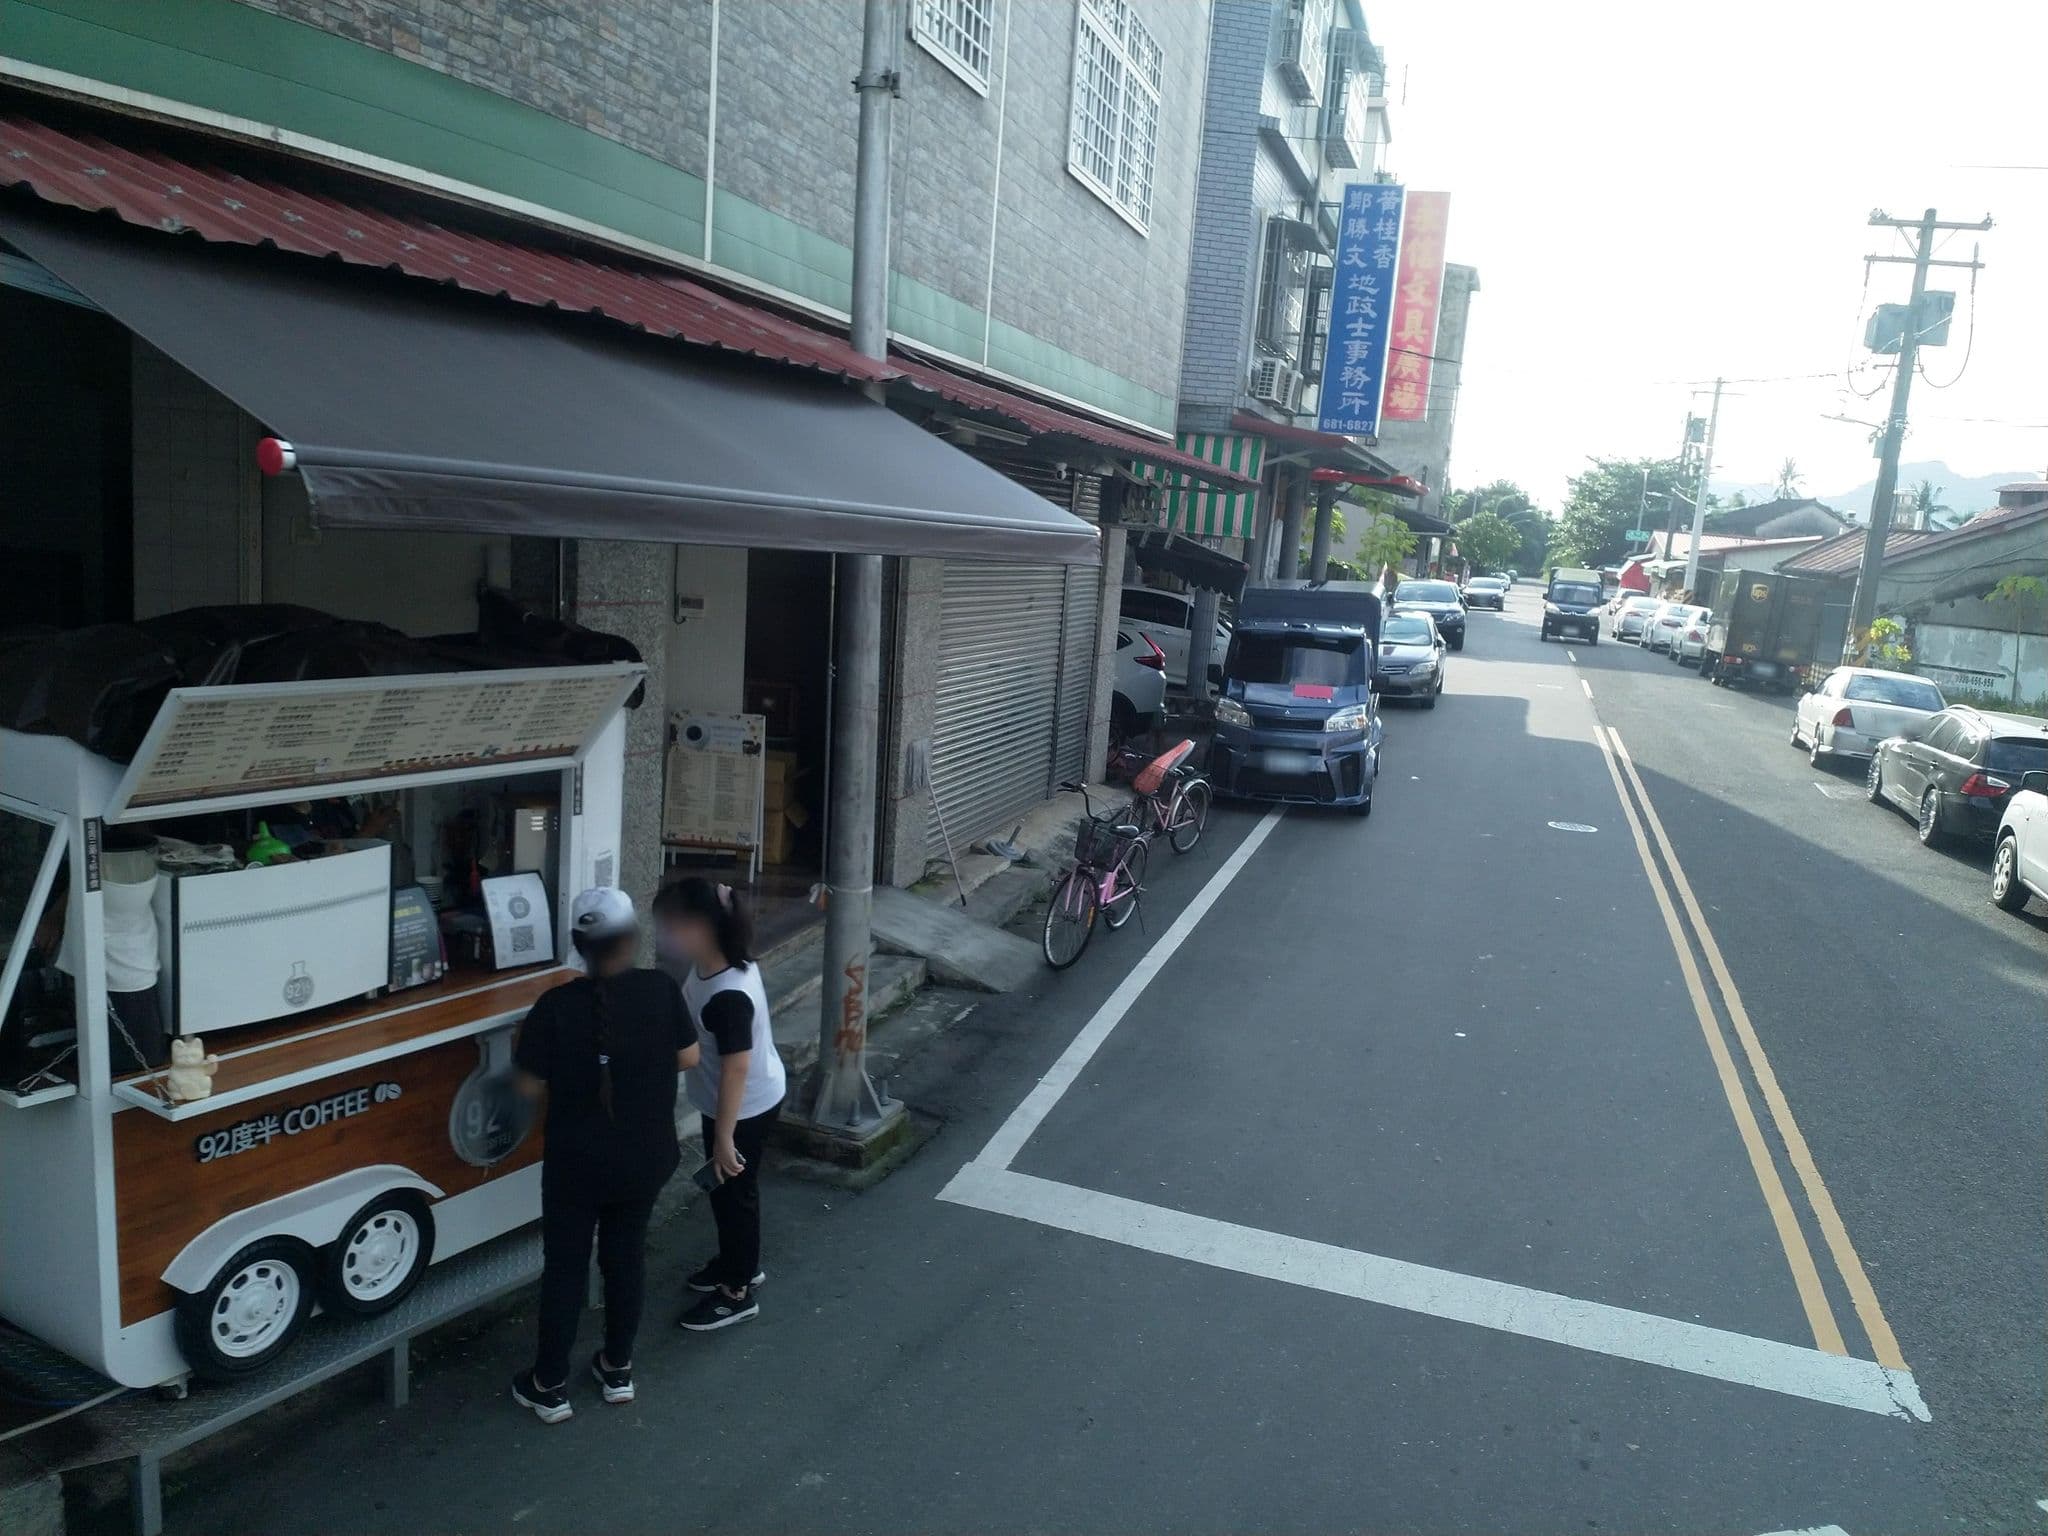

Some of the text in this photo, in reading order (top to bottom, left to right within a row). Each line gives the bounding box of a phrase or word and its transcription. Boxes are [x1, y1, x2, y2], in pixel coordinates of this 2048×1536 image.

[1343, 190, 1373, 269] 鄭勝文
[1372, 190, 1402, 269] 黃桂香
[1338, 273, 1380, 416] 地政士事務所
[1323, 418, 1374, 431] 681-6827
[199, 1088, 370, 1164] 92度半 COFFEE
